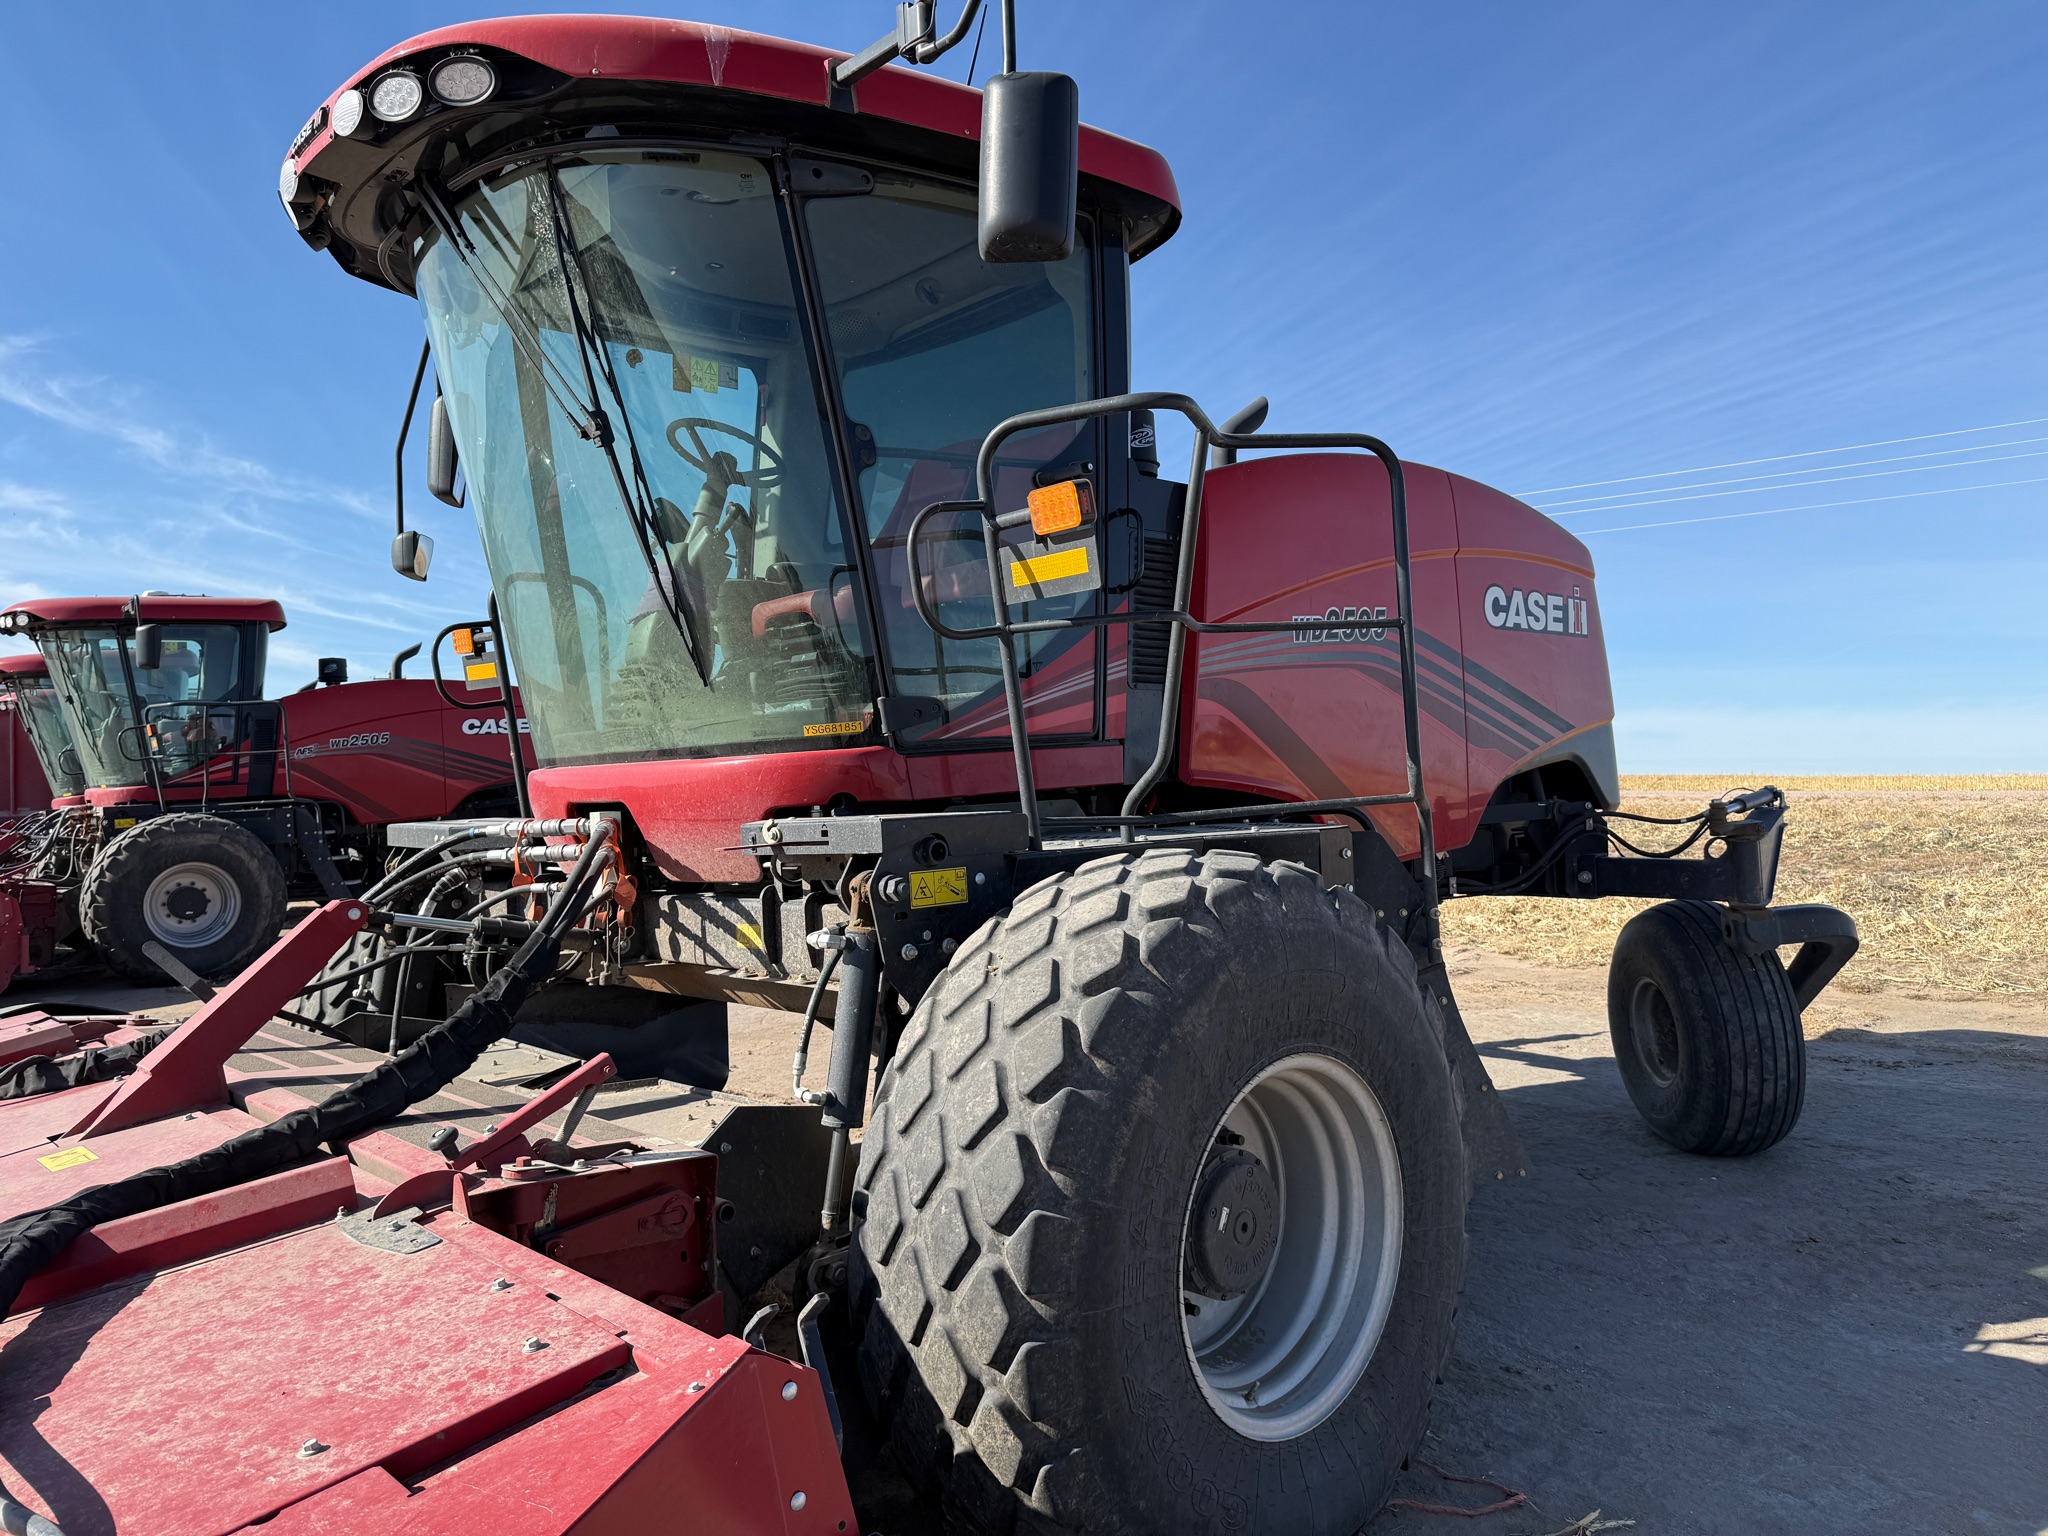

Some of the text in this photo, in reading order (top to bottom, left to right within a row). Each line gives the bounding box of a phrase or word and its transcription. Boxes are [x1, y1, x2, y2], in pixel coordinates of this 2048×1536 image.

[1484, 586, 1564, 632] CASE
[1292, 606, 1388, 643] WD2505
[329, 732, 390, 749] WD2505
[804, 721, 863, 735] YSG681851
